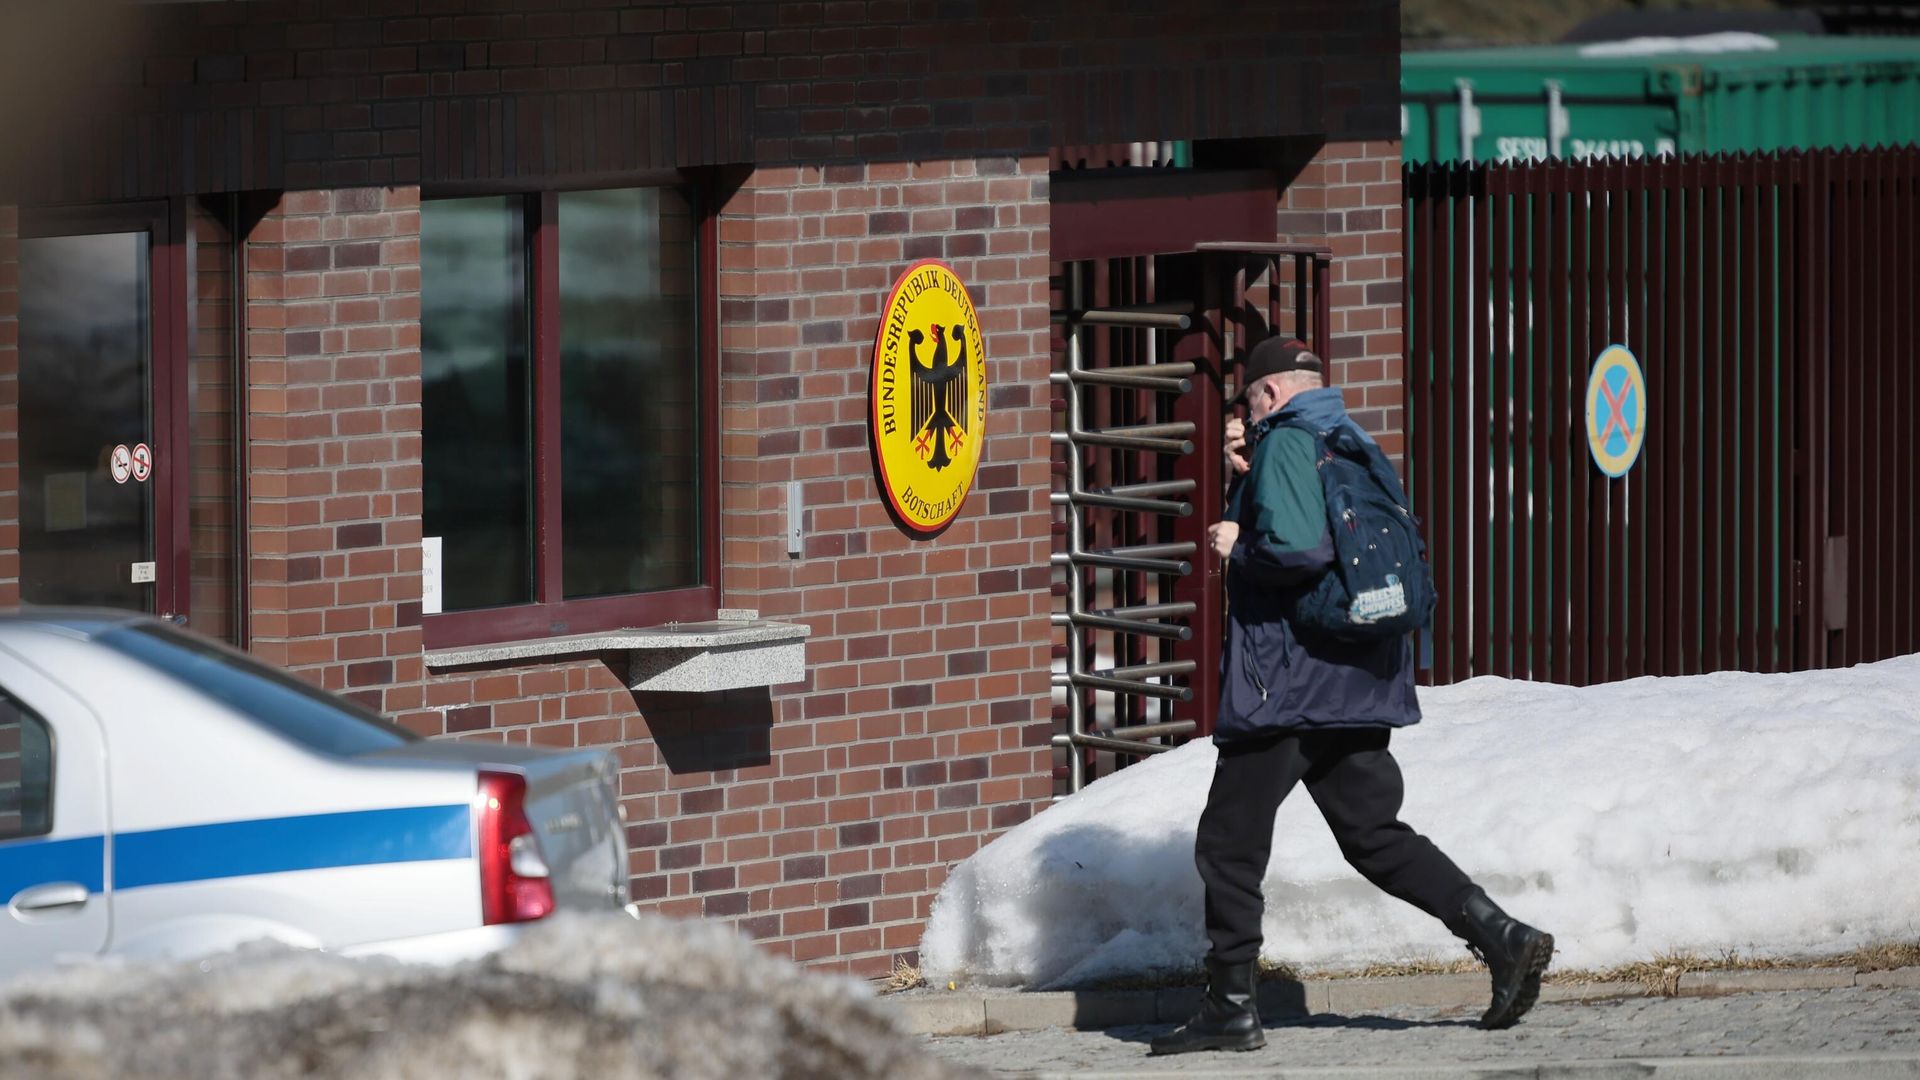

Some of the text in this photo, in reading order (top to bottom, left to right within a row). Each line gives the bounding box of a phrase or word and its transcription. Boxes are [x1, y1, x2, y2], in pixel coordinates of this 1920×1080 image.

[882, 270, 985, 436] BUNDESREPUBLIK DEUTSCHLAND
[901, 481, 963, 520] BOTSCHAFT
